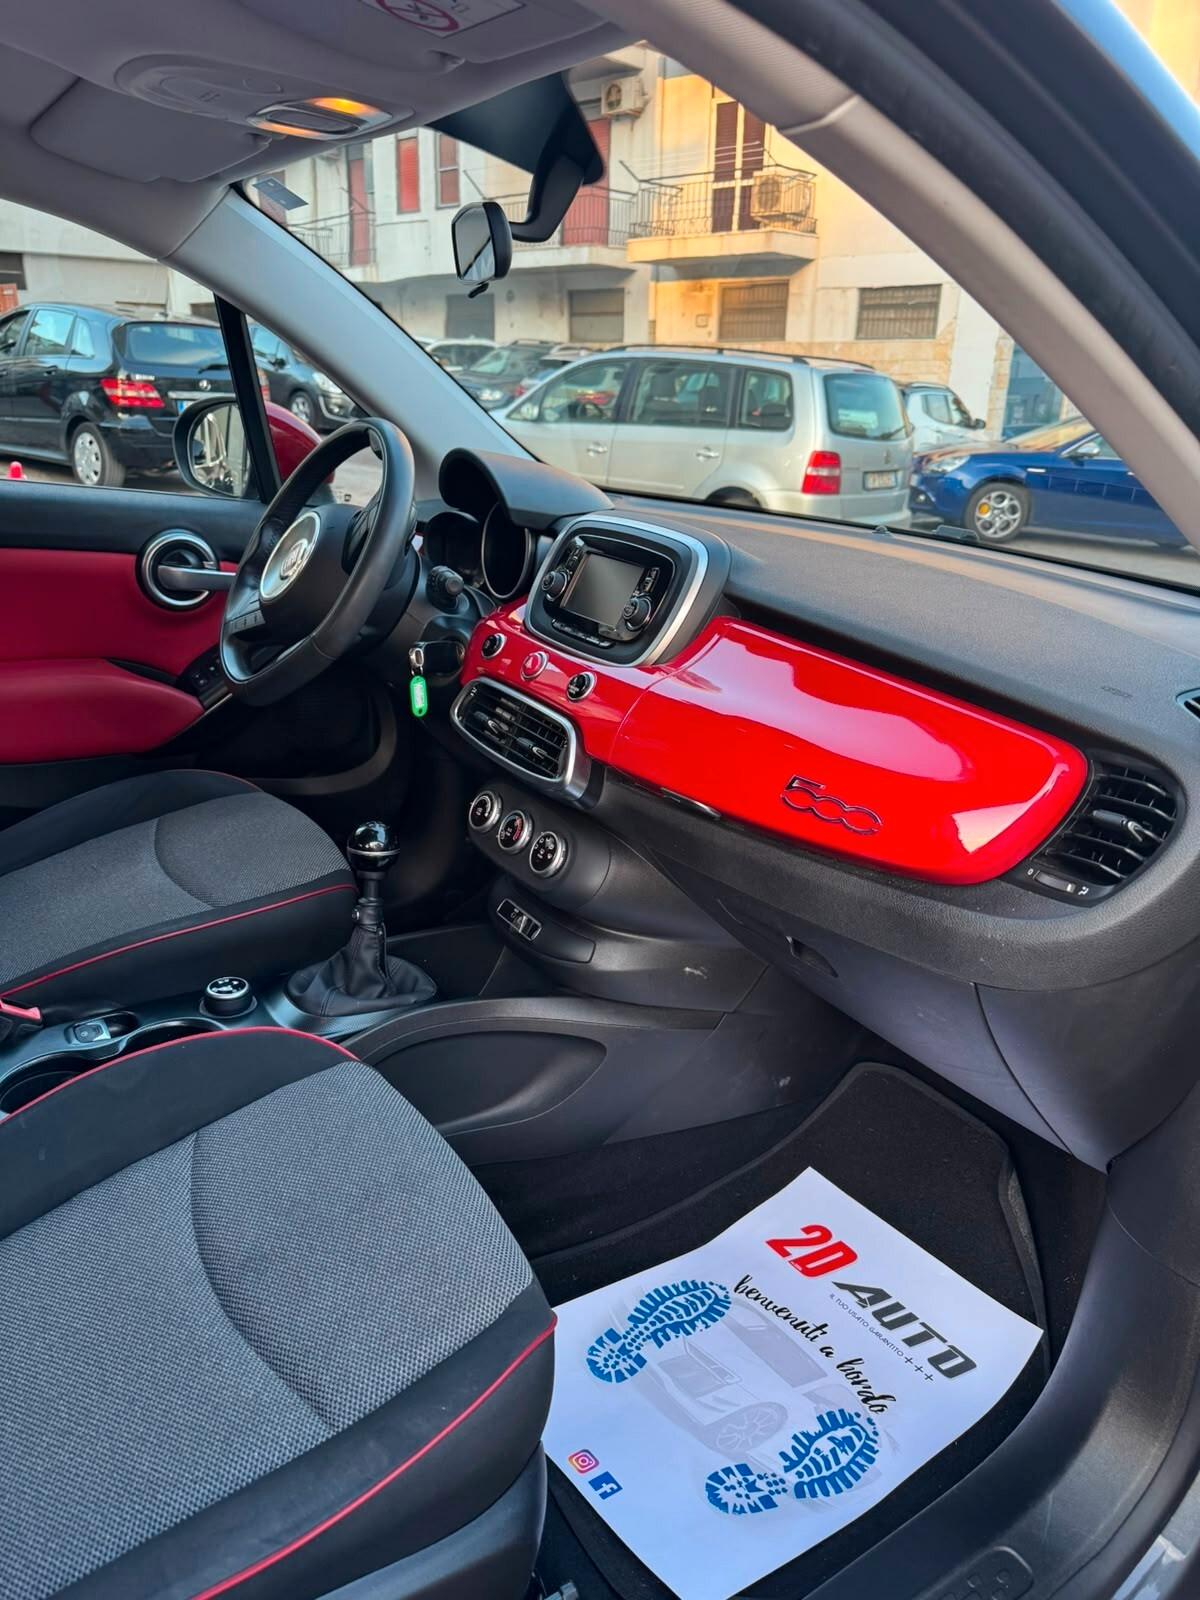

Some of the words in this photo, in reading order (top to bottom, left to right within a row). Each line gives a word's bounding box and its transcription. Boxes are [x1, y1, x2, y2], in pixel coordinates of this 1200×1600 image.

[780, 774, 882, 835] 500
[733, 1274, 829, 1342] benvenuti
[819, 1346, 835, 1358] a
[836, 1357, 897, 1414] bordo
[765, 1224, 858, 1278] 2D
[832, 1281, 977, 1379] AUTO
[836, 1298, 849, 1310] TUO
[848, 1309, 869, 1328] USATO
[868, 1327, 904, 1357] GARANTITO
